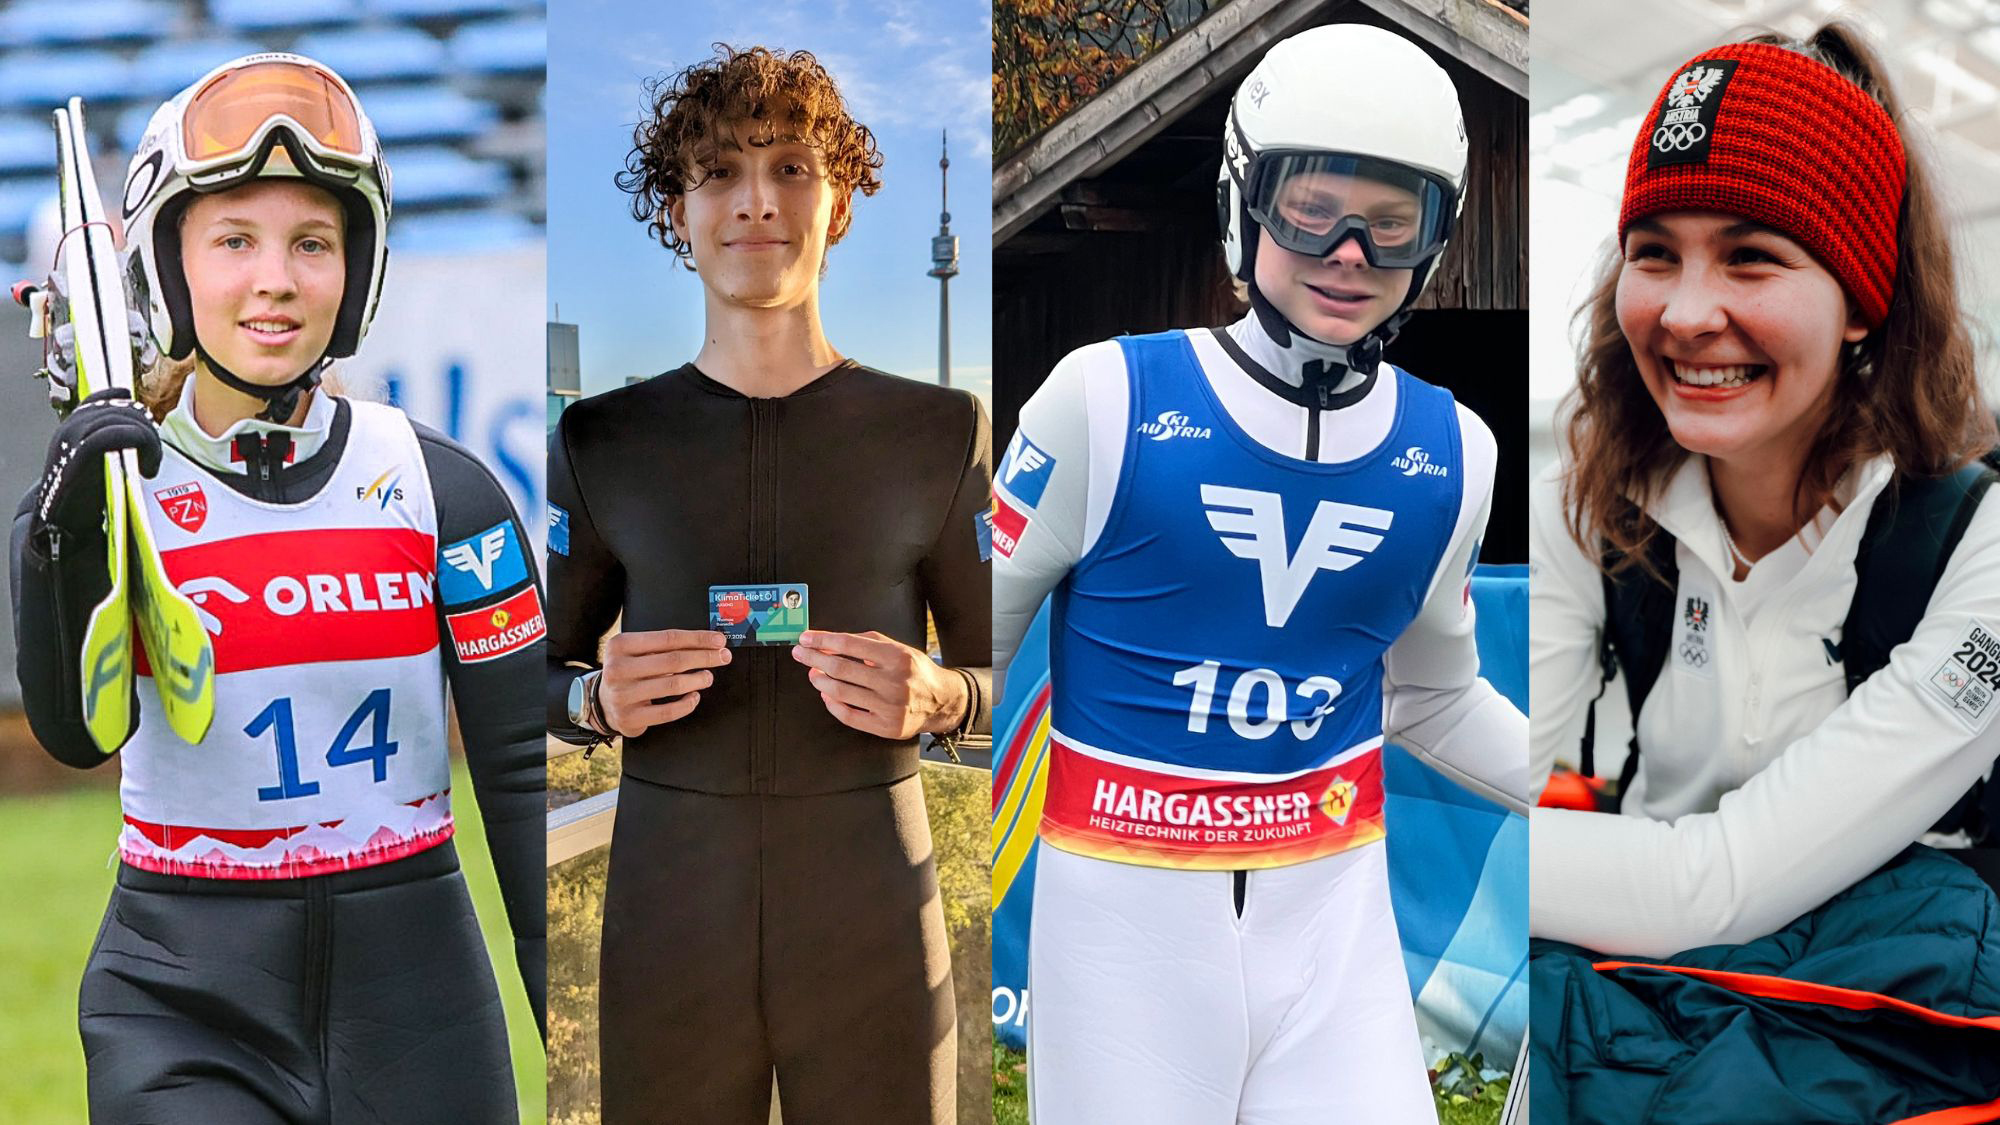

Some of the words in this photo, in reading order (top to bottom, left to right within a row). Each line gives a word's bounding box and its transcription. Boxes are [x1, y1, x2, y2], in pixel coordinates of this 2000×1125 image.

[1136, 421, 1212, 440] AUSTRIA
[1157, 410, 1190, 427] SKI
[1390, 456, 1448, 477] AUSTRIA
[1406, 446, 1430, 463] SKI
[263, 571, 435, 616] ORLEN
[457, 614, 544, 657] HARGASSNER
[1969, 627, 2000, 664] GANG
[1952, 641, 2000, 692] 2024
[1172, 660, 1343, 742] 103
[243, 688, 399, 802] 14
[1092, 778, 1312, 828] HARGASSNER
[1089, 814, 1201, 843] HEIZTECHNIK
[1204, 830, 1239, 843] DER
[1243, 822, 1312, 842] ZUKUNFT
